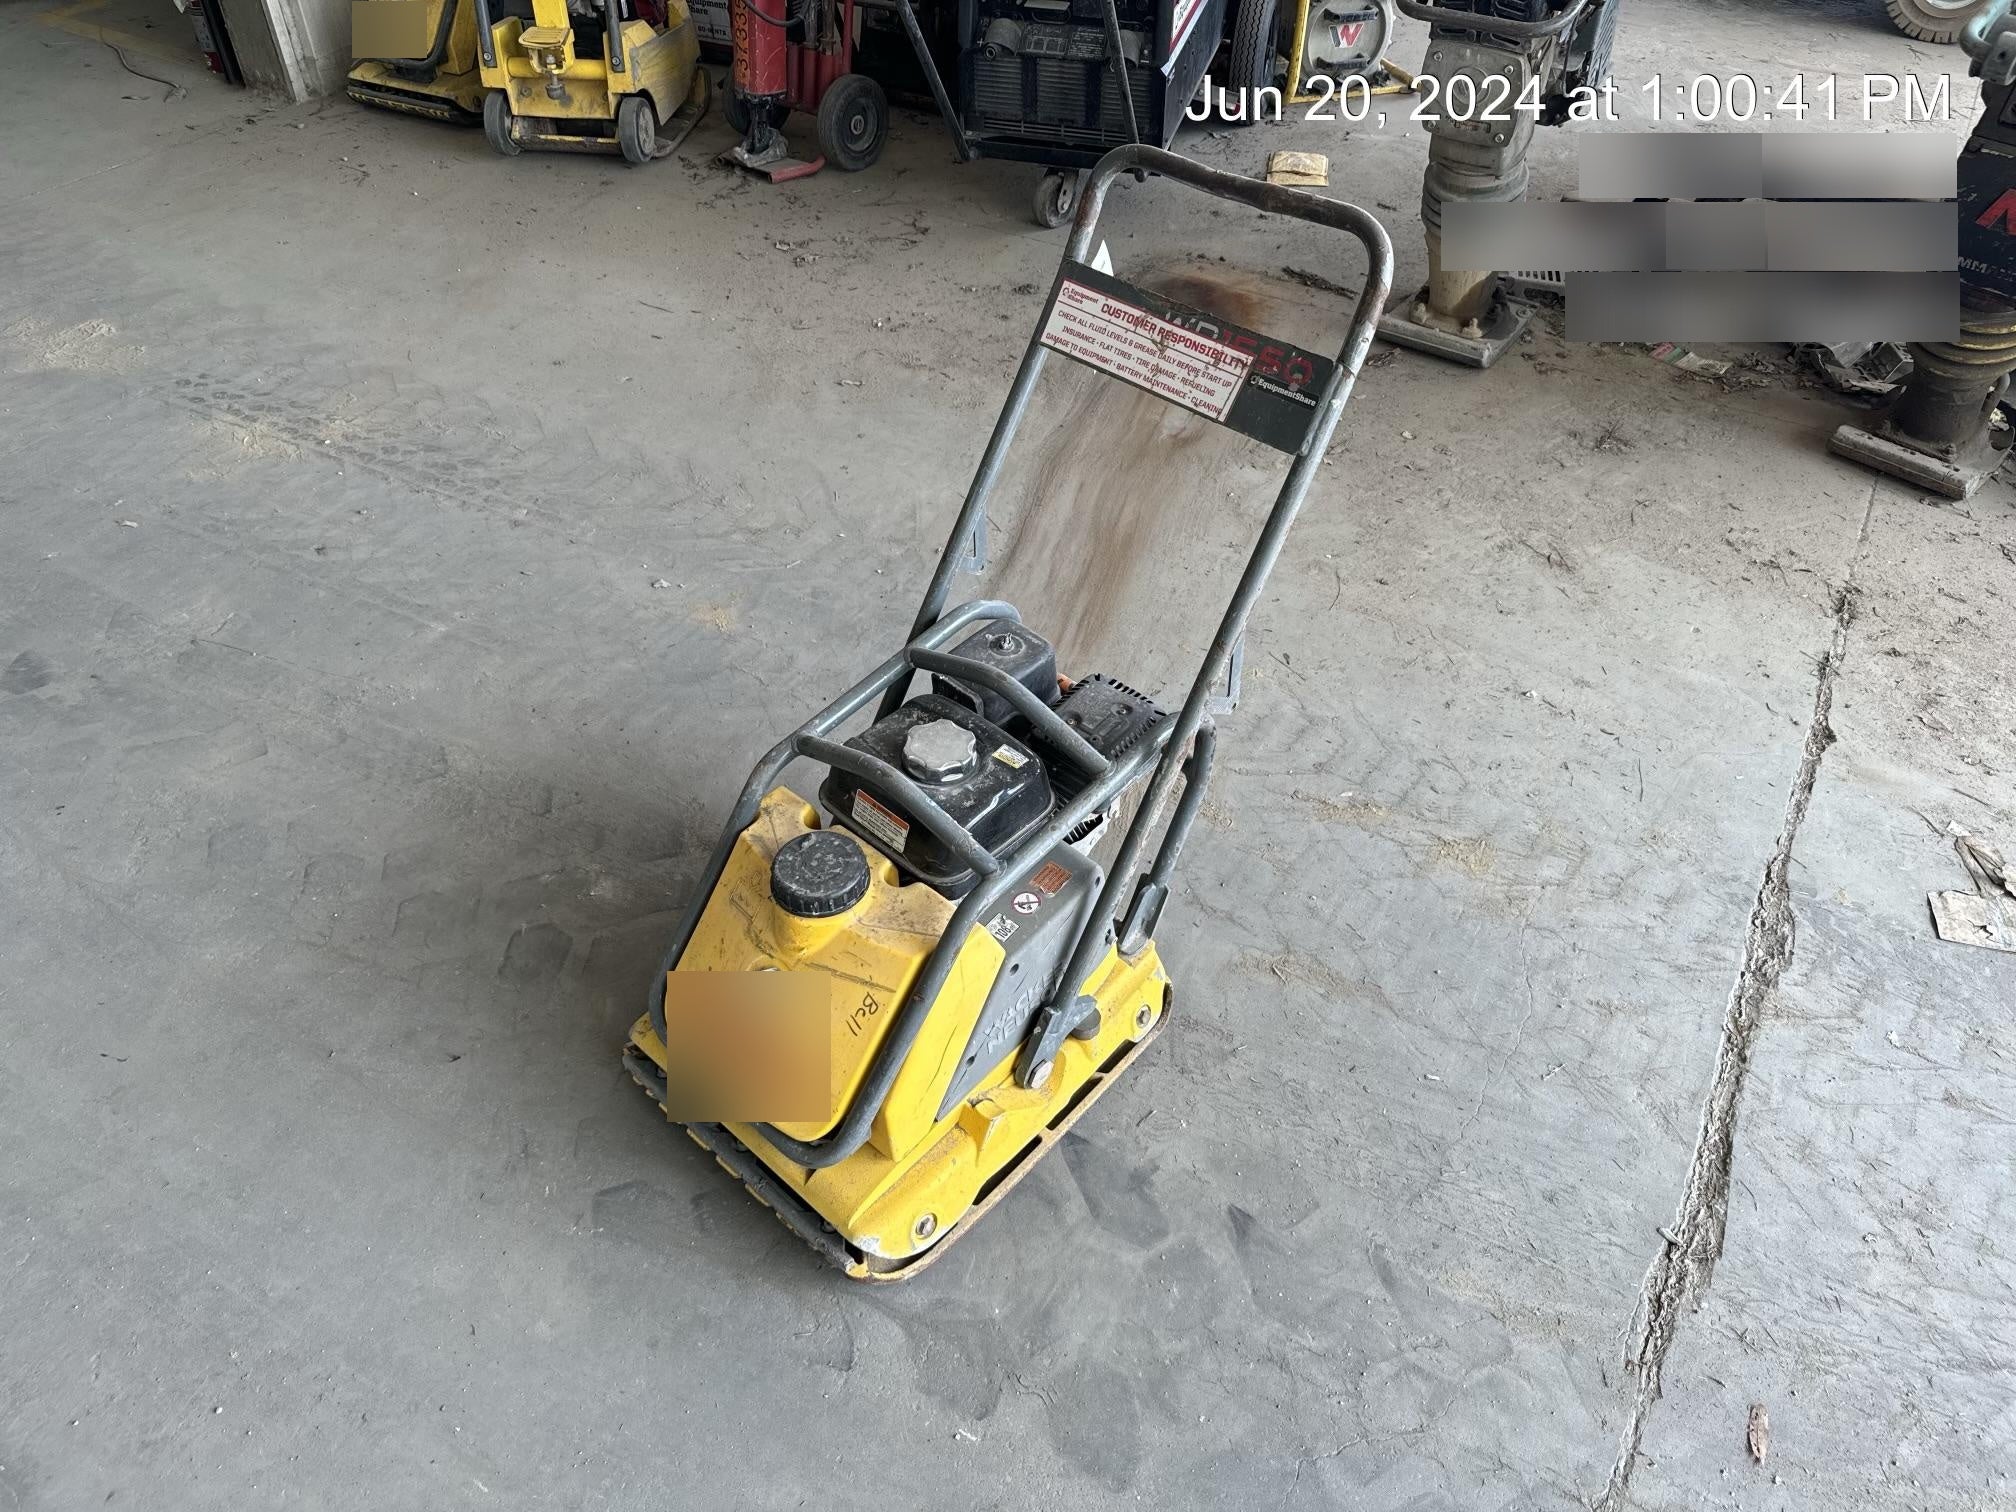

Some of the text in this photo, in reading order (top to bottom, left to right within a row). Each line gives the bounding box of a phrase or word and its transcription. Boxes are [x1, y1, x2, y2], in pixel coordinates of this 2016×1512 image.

[686, 0, 728, 10] quipment
[1070, 288, 1099, 304] Equipment
[1058, 310, 1078, 323] CHECK
[1077, 317, 1088, 328] ALL
[1088, 323, 1107, 336] FLUID
[1106, 330, 1129, 345] LEVELS
[1133, 341, 1157, 357] GREASE
[1157, 352, 1176, 365] DAILY
[1176, 360, 1201, 375] BEFORE
[1200, 372, 1222, 384] START
[1222, 380, 1233, 389] UP
[1061, 325, 1216, 397] INSURANCE FLAT TIRES TIRE DAMAGE REFUELING
[1100, 303, 1248, 371] CUSTOMER RESPONSIBILITY
[1045, 332, 1070, 348] DAMAGE
[1078, 346, 1113, 367] EQUIPMENT
[1116, 362, 1143, 379] BATTERY
[1142, 375, 1188, 400] MAINTENANCE
[1190, 396, 1223, 416] CLEANING
[1258, 378, 1317, 407] EquipmentShare
